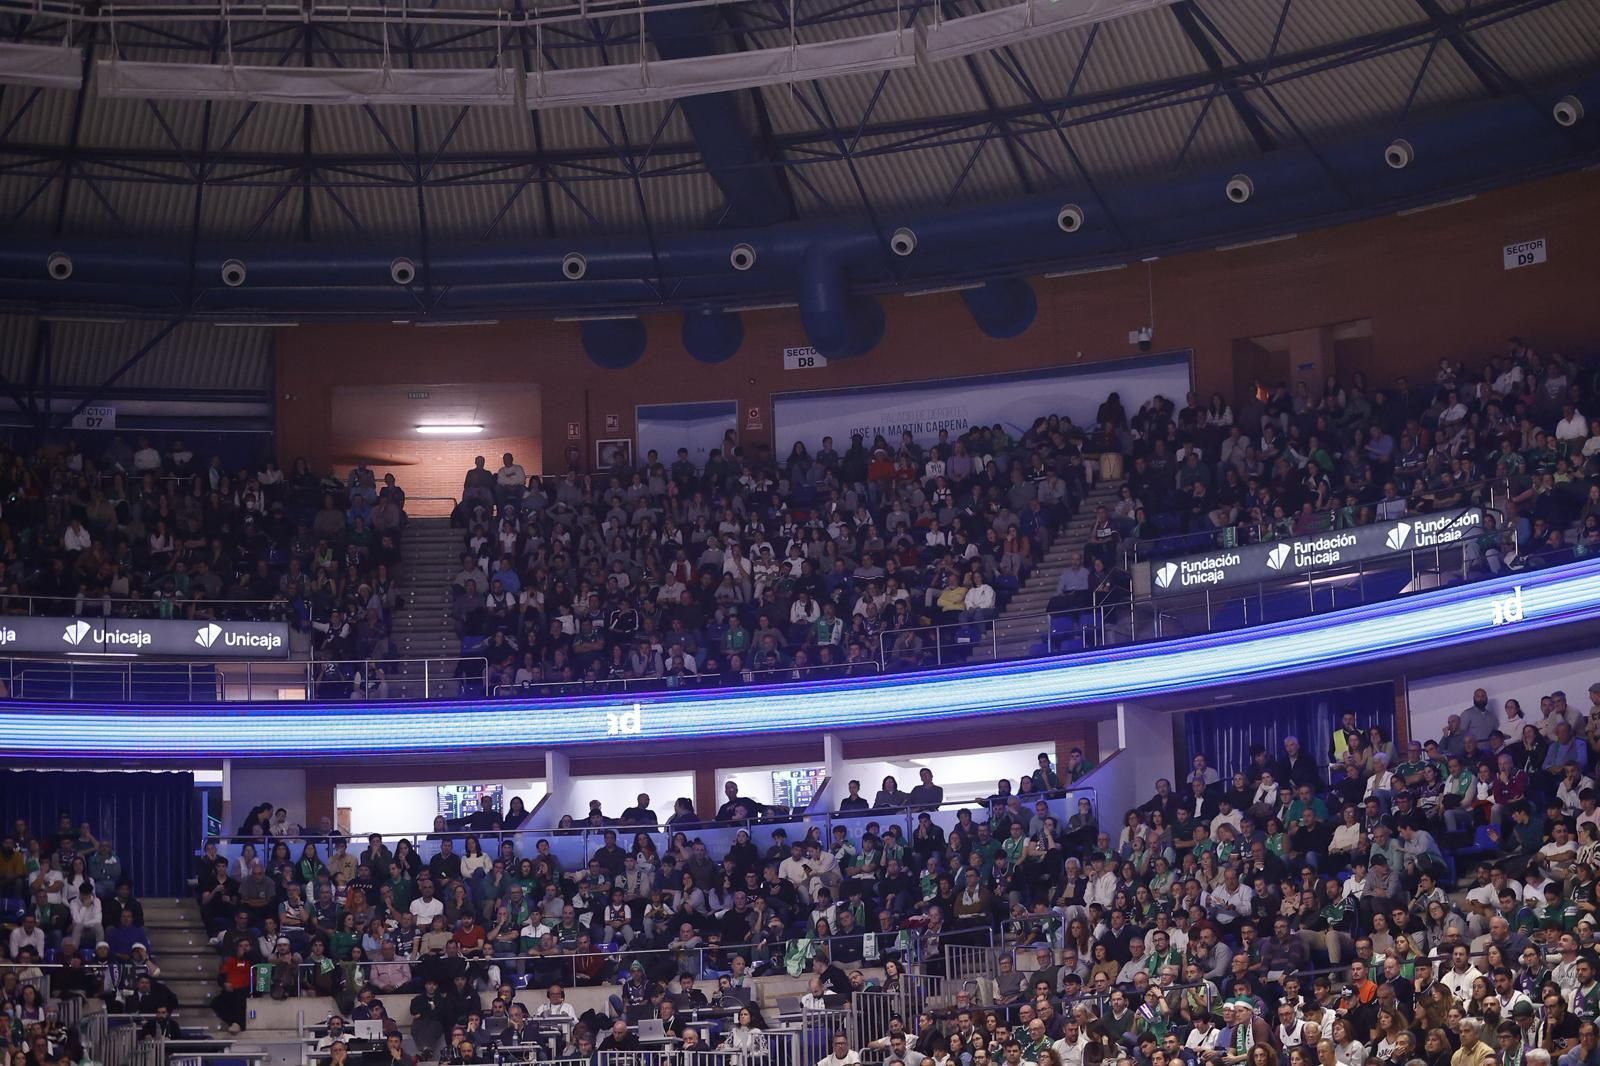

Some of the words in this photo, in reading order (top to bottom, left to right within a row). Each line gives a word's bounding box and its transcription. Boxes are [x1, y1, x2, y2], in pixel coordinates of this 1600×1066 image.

[1506, 240, 1543, 255] SECTOR
[1518, 252, 1534, 265] D9
[787, 347, 817, 357] SECTO
[798, 357, 815, 367] D8
[79, 407, 113, 416] ECTOR
[86, 417, 104, 427] D7
[1294, 533, 1357, 555] Fundación
[1180, 552, 1241, 575] Fundación
[1294, 548, 1340, 568] Unicaja
[1181, 568, 1225, 586] Unicaja
[93, 628, 152, 648] Unicaja
[224, 631, 282, 651] Unicaja
